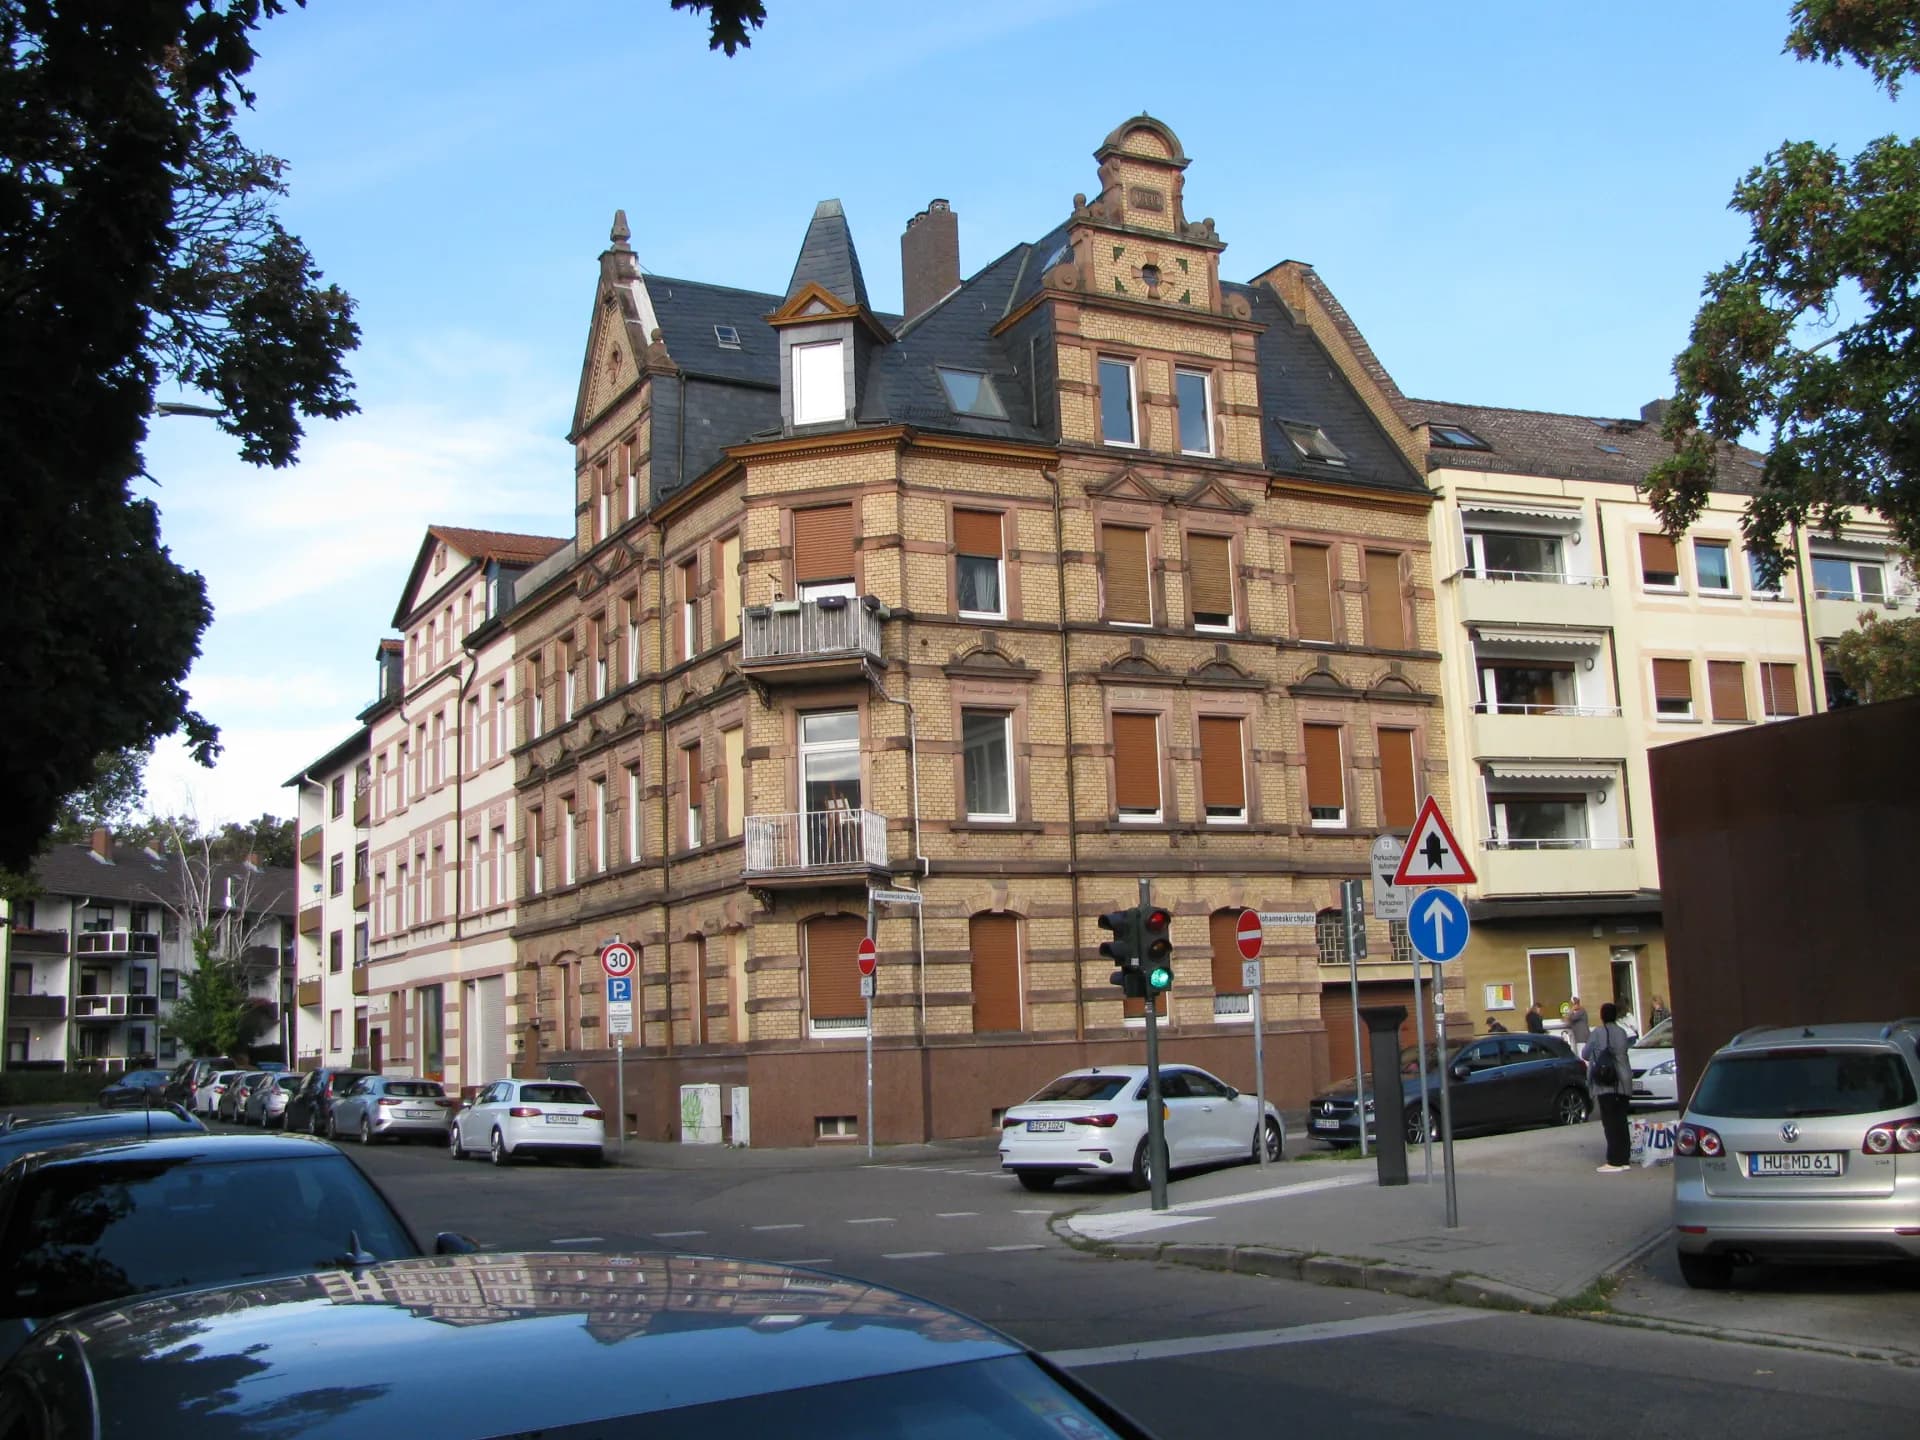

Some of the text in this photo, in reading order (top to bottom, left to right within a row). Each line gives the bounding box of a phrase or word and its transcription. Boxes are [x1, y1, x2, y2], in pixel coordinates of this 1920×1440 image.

[609, 952, 628, 968] 30
[613, 981, 626, 999] P
[1763, 1155, 1832, 1169] HU MD 61
